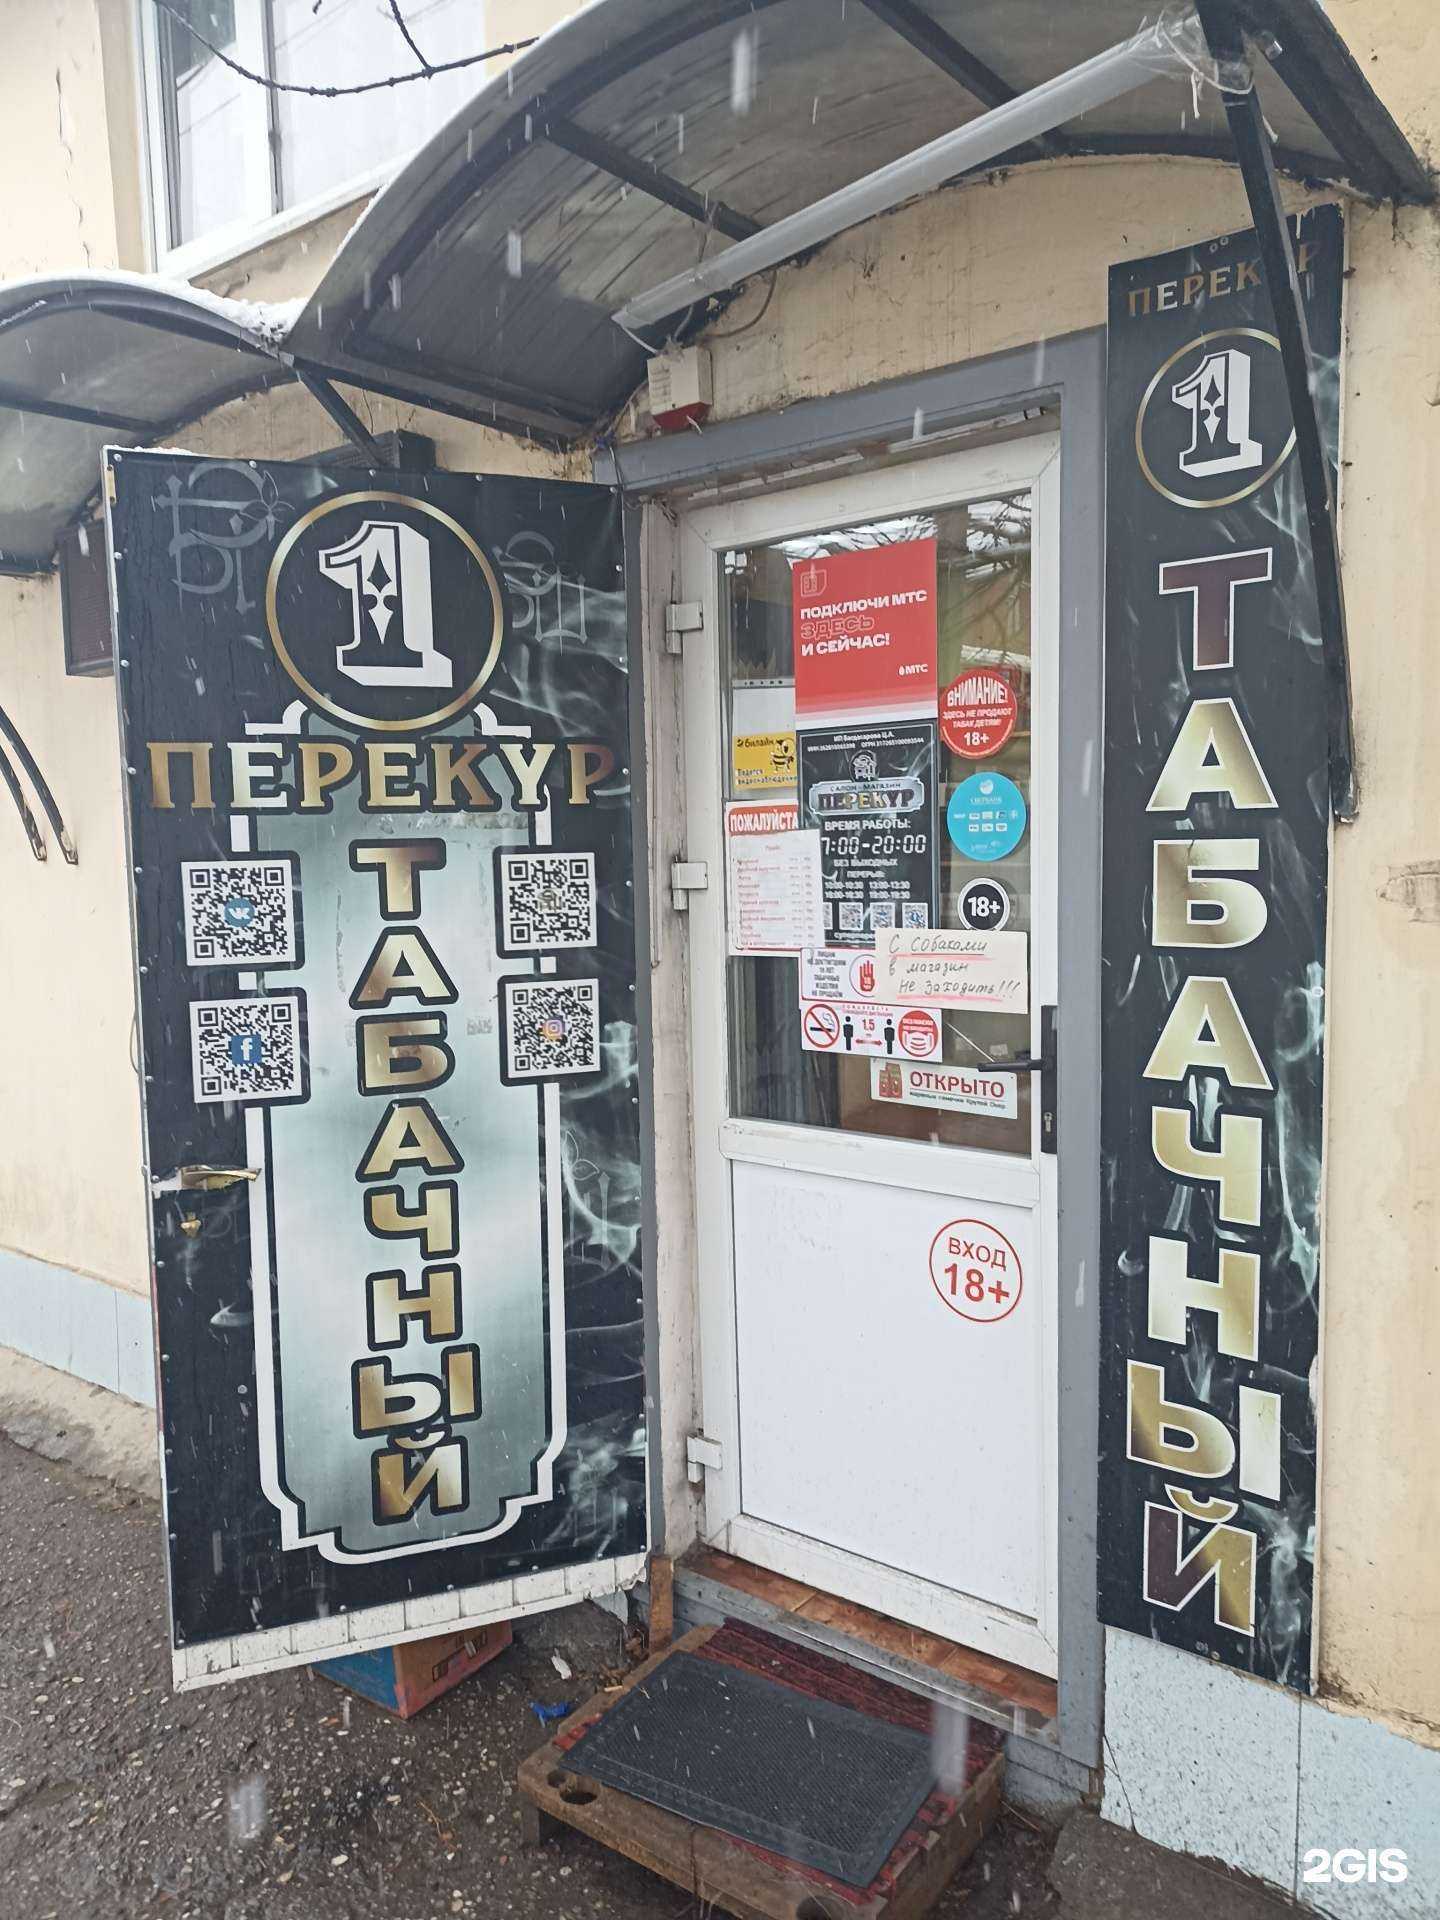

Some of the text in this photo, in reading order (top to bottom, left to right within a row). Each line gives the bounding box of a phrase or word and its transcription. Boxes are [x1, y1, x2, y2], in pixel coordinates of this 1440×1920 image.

[1129, 242, 1320, 317] ПЕРЕКР
[1172, 349, 1262, 478] 1
[319, 520, 452, 688] 1
[800, 589, 928, 620] ПОДКЛЮЧИ МТС
[800, 615, 875, 640] ЗДЕСЬ
[801, 632, 890, 657] И СЕЙЧАС!
[905, 664, 929, 675] МТС
[947, 676, 1008, 707] ВНИМАНИЕ!
[964, 731, 989, 746] 18+
[146, 741, 614, 809] ПЕРЕКУР
[817, 788, 915, 810] ПЕРЕКУР
[730, 808, 799, 832] ПОЖАЛУЙСТА
[824, 818, 911, 831] ВРЕМЯ РАБОТЫ:
[968, 896, 1000, 917] 18+
[906, 962, 969, 977] магазин
[909, 1070, 1005, 1098] ОТКРЫТО
[1126, 547, 1281, 1638] ТАБАЧНЫЙ
[353, 845, 477, 1519] ТАБАЧНЫЙ
[949, 1237, 1007, 1272] ВХОД
[944, 1263, 1010, 1304] 18+
